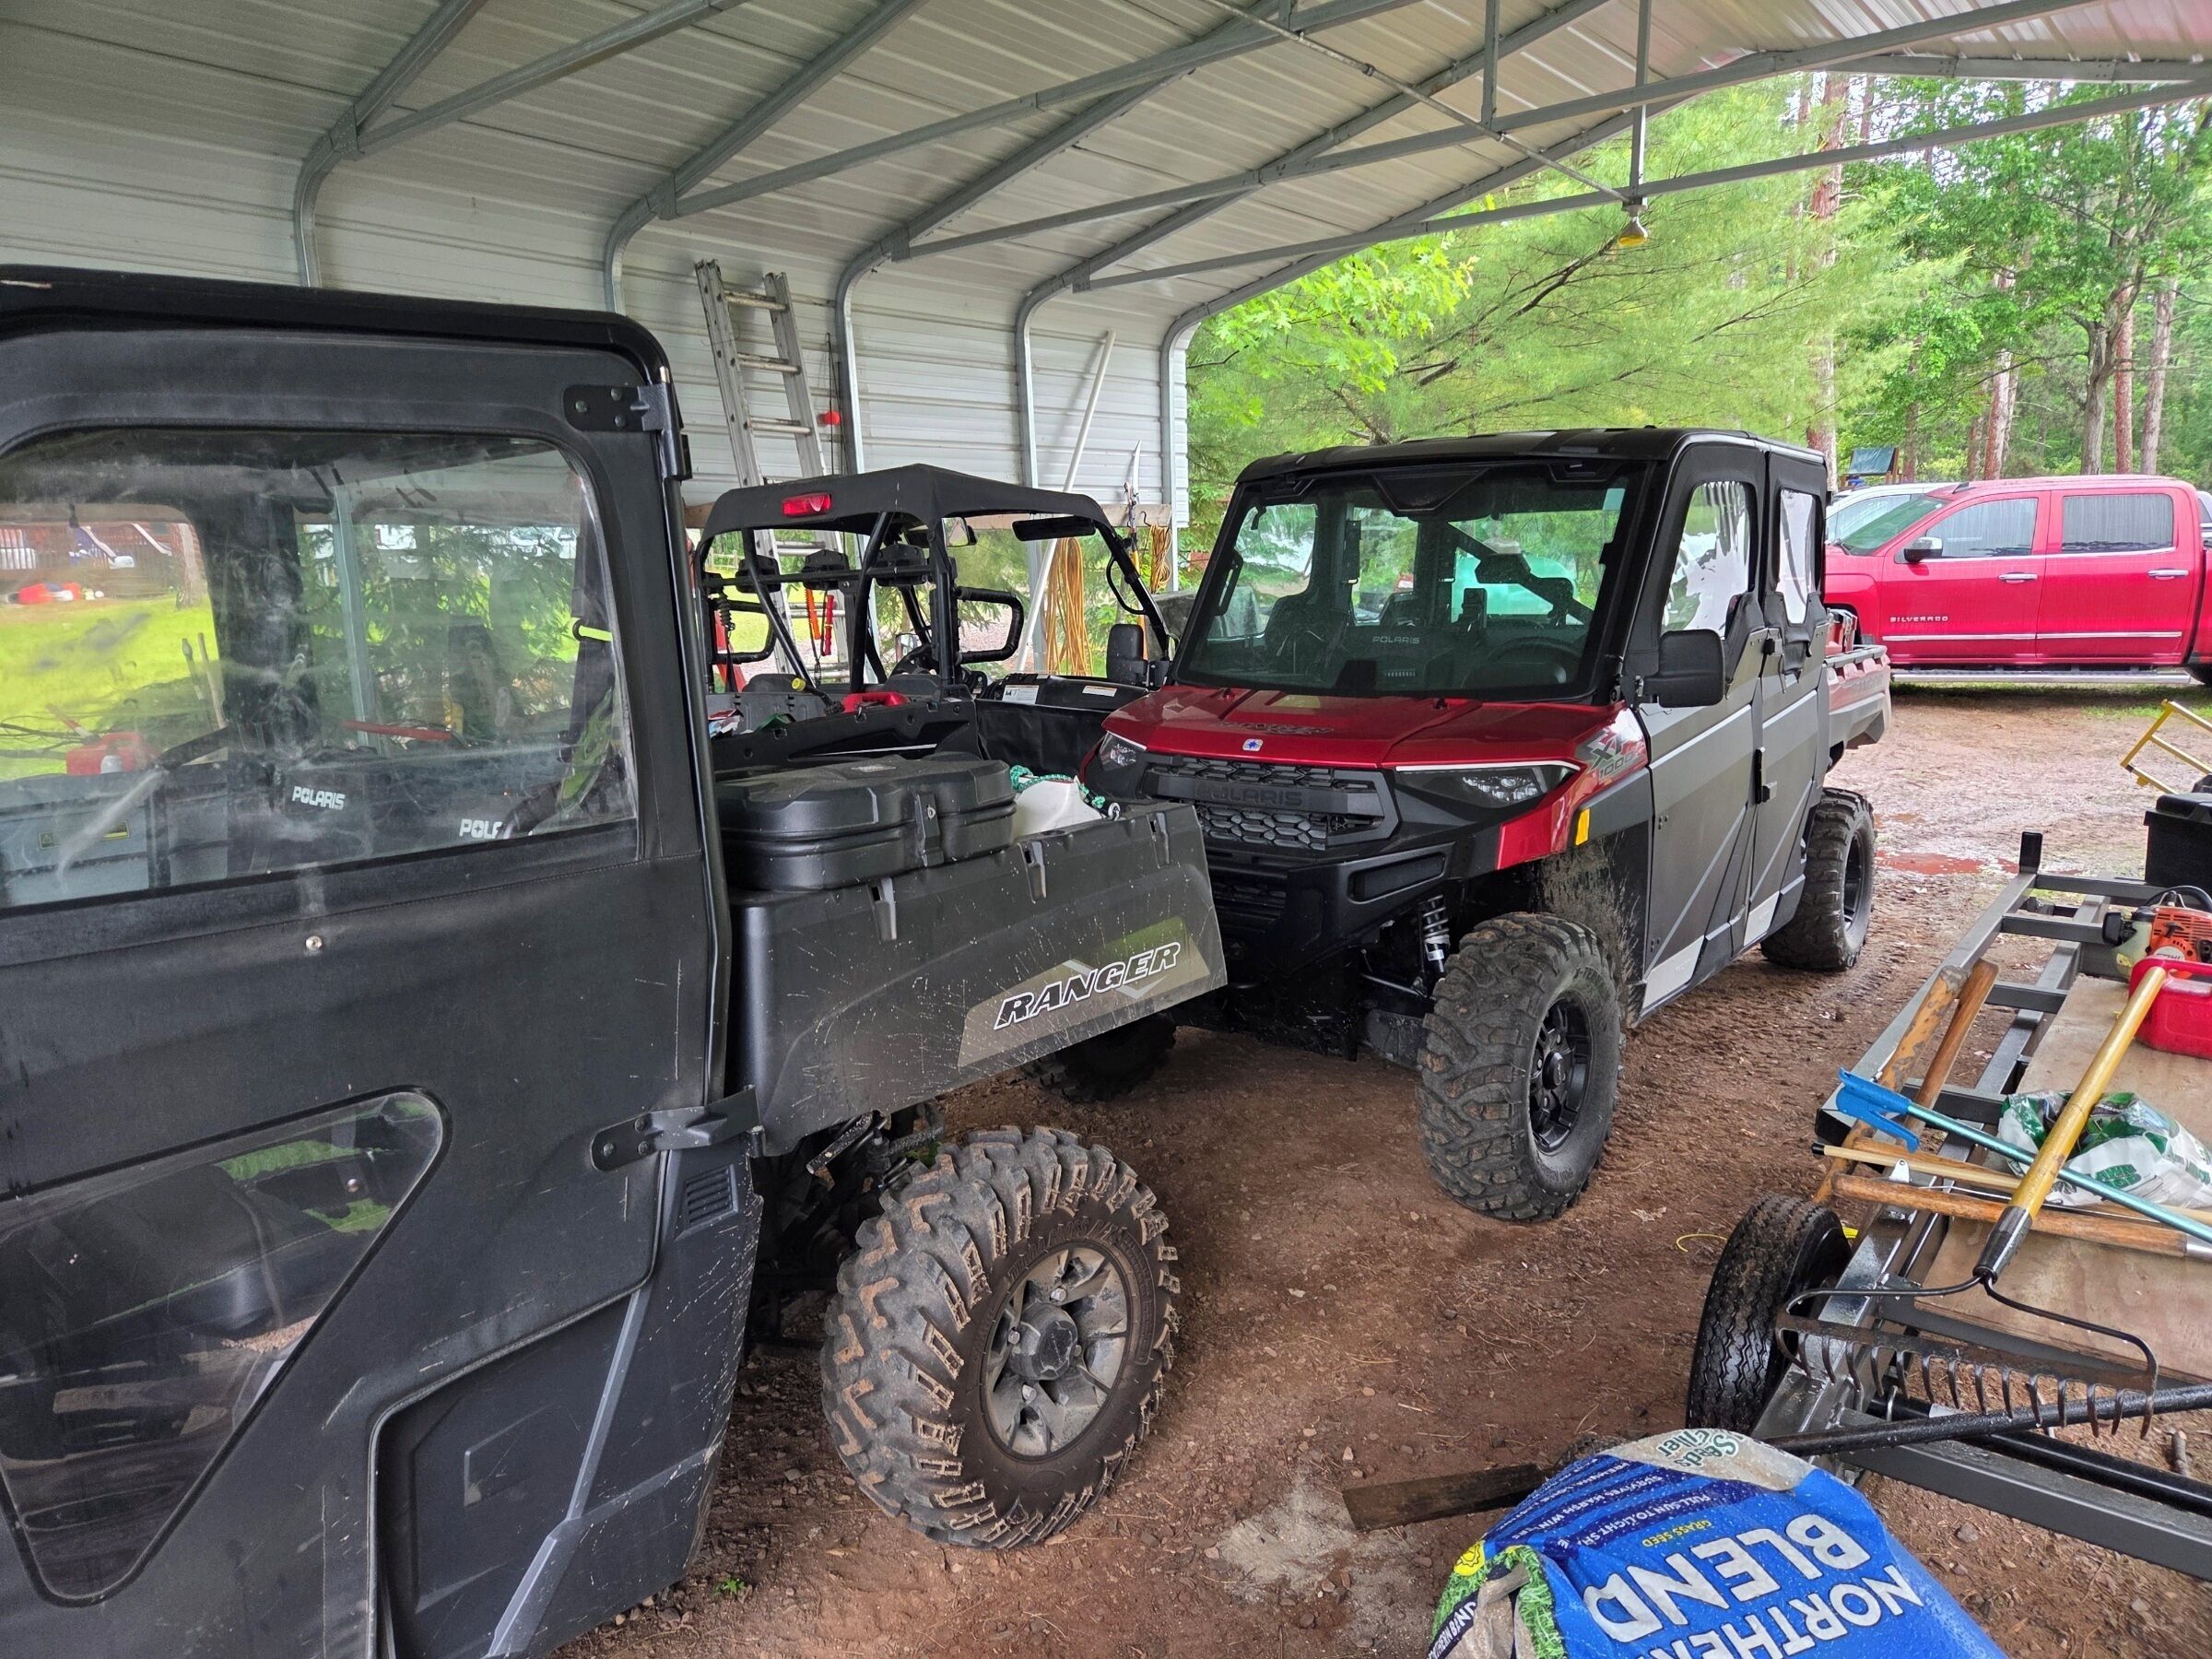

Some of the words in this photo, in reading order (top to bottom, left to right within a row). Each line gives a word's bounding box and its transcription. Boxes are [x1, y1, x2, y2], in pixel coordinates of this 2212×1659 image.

[1372, 636, 1420, 644] POLARIS
[292, 786, 346, 810] POLARIS
[994, 942, 1181, 1030] RANGER
[1673, 1433, 1738, 1467] Seeds
[1604, 1475, 1663, 1497] SURVIVES
[1563, 1495, 1605, 1514] HARSH
[1653, 1502, 1680, 1515] SUN
[1680, 1493, 1712, 1508] FULL
[1599, 1512, 1637, 1537] LIGHT
[1635, 1509, 1656, 1521] TO
[1672, 1520, 1712, 1536] GRASS
[1557, 1533, 1602, 1550] SHE
[1641, 1532, 1674, 1547] SEED
[1583, 1513, 1872, 1642] BLEND
[1637, 1564, 1924, 1659] NORTHE
